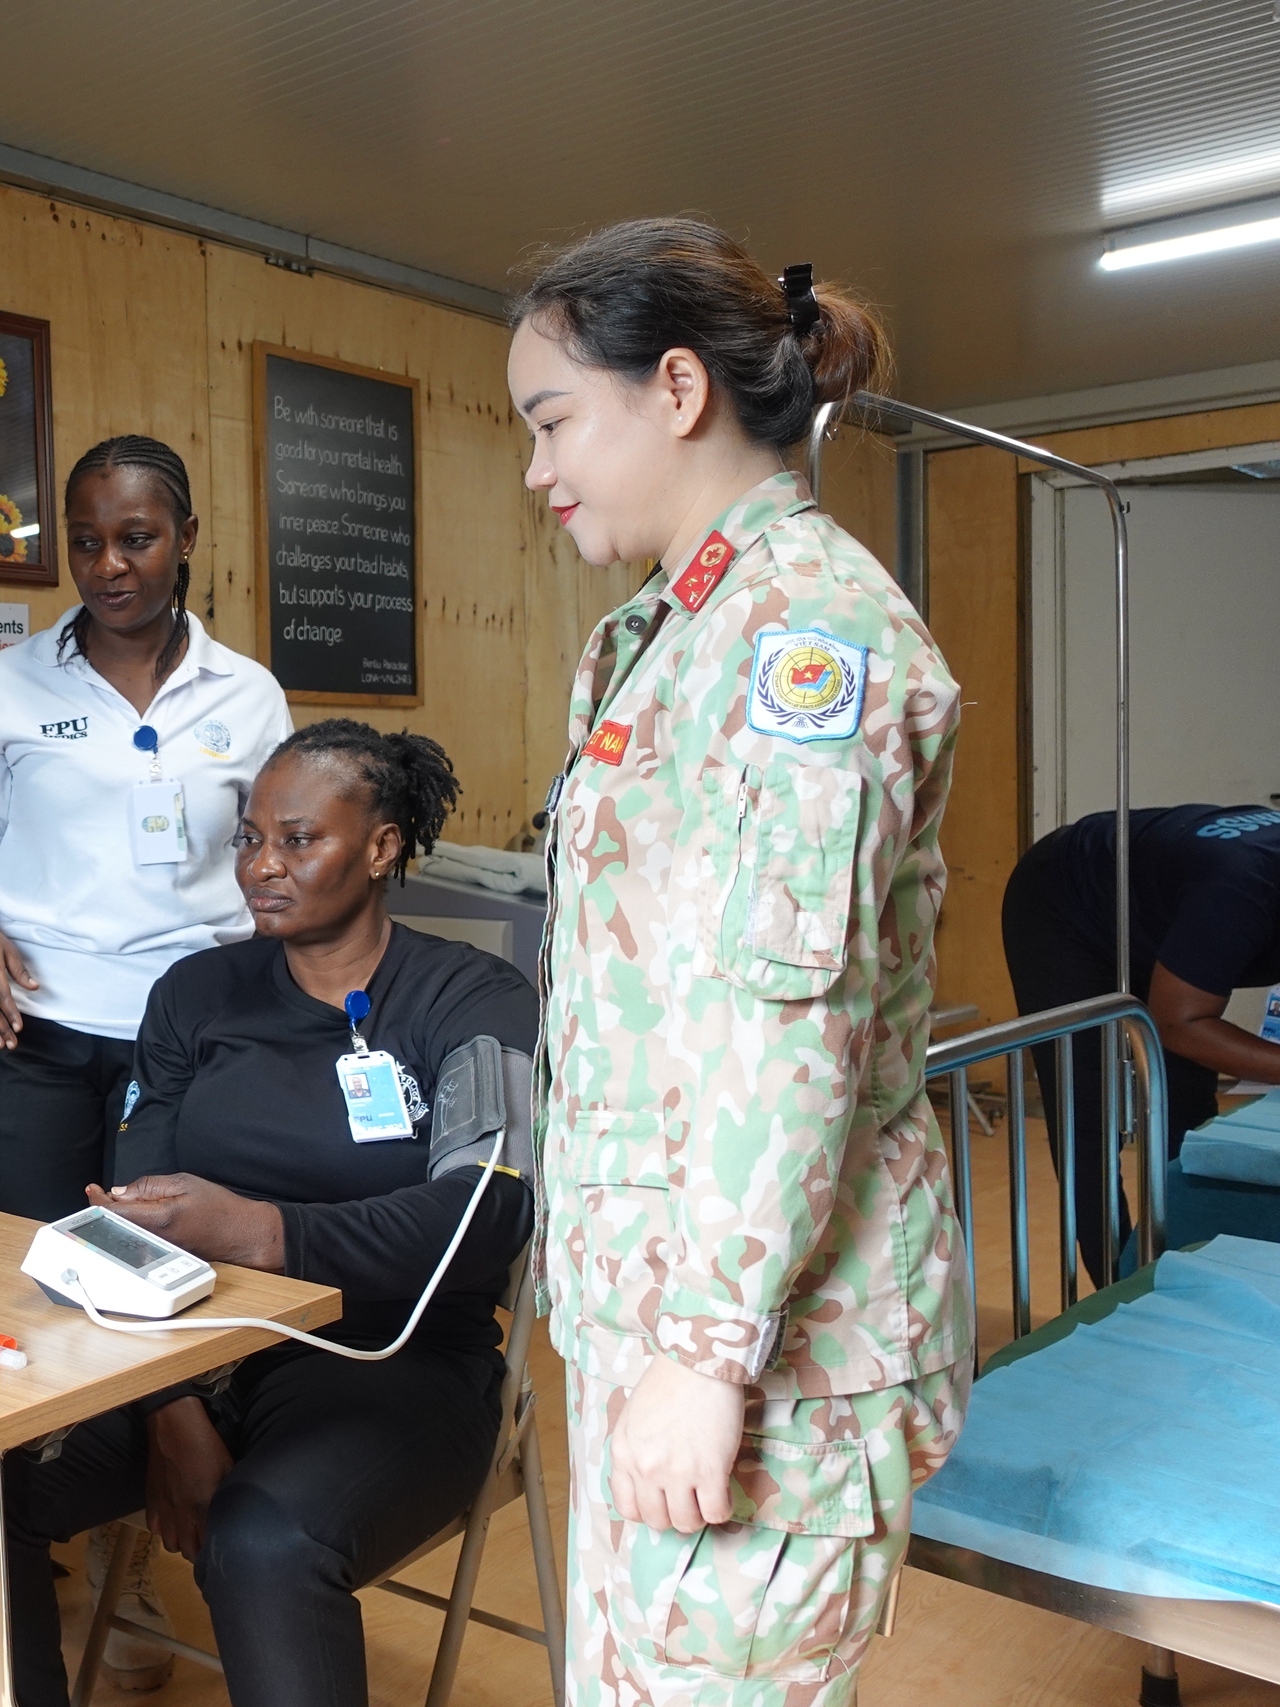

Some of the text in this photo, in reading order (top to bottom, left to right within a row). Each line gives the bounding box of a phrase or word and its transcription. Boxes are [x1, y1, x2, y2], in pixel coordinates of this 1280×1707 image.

[274, 395, 398, 441] Be with someone that is
[275, 440, 301, 460] good
[304, 440, 317, 460] for
[342, 449, 371, 470] mental
[276, 469, 406, 512] Someone who brings you
[280, 514, 304, 531] inner
[341, 513, 389, 542] Someone
[390, 527, 410, 546] who
[276, 543, 332, 572] challenges
[334, 556, 355, 573] your
[357, 552, 378, 574] bad
[279, 582, 413, 612] but supports your process
[283, 618, 295, 640] of
[39, 716, 88, 735] FPU
